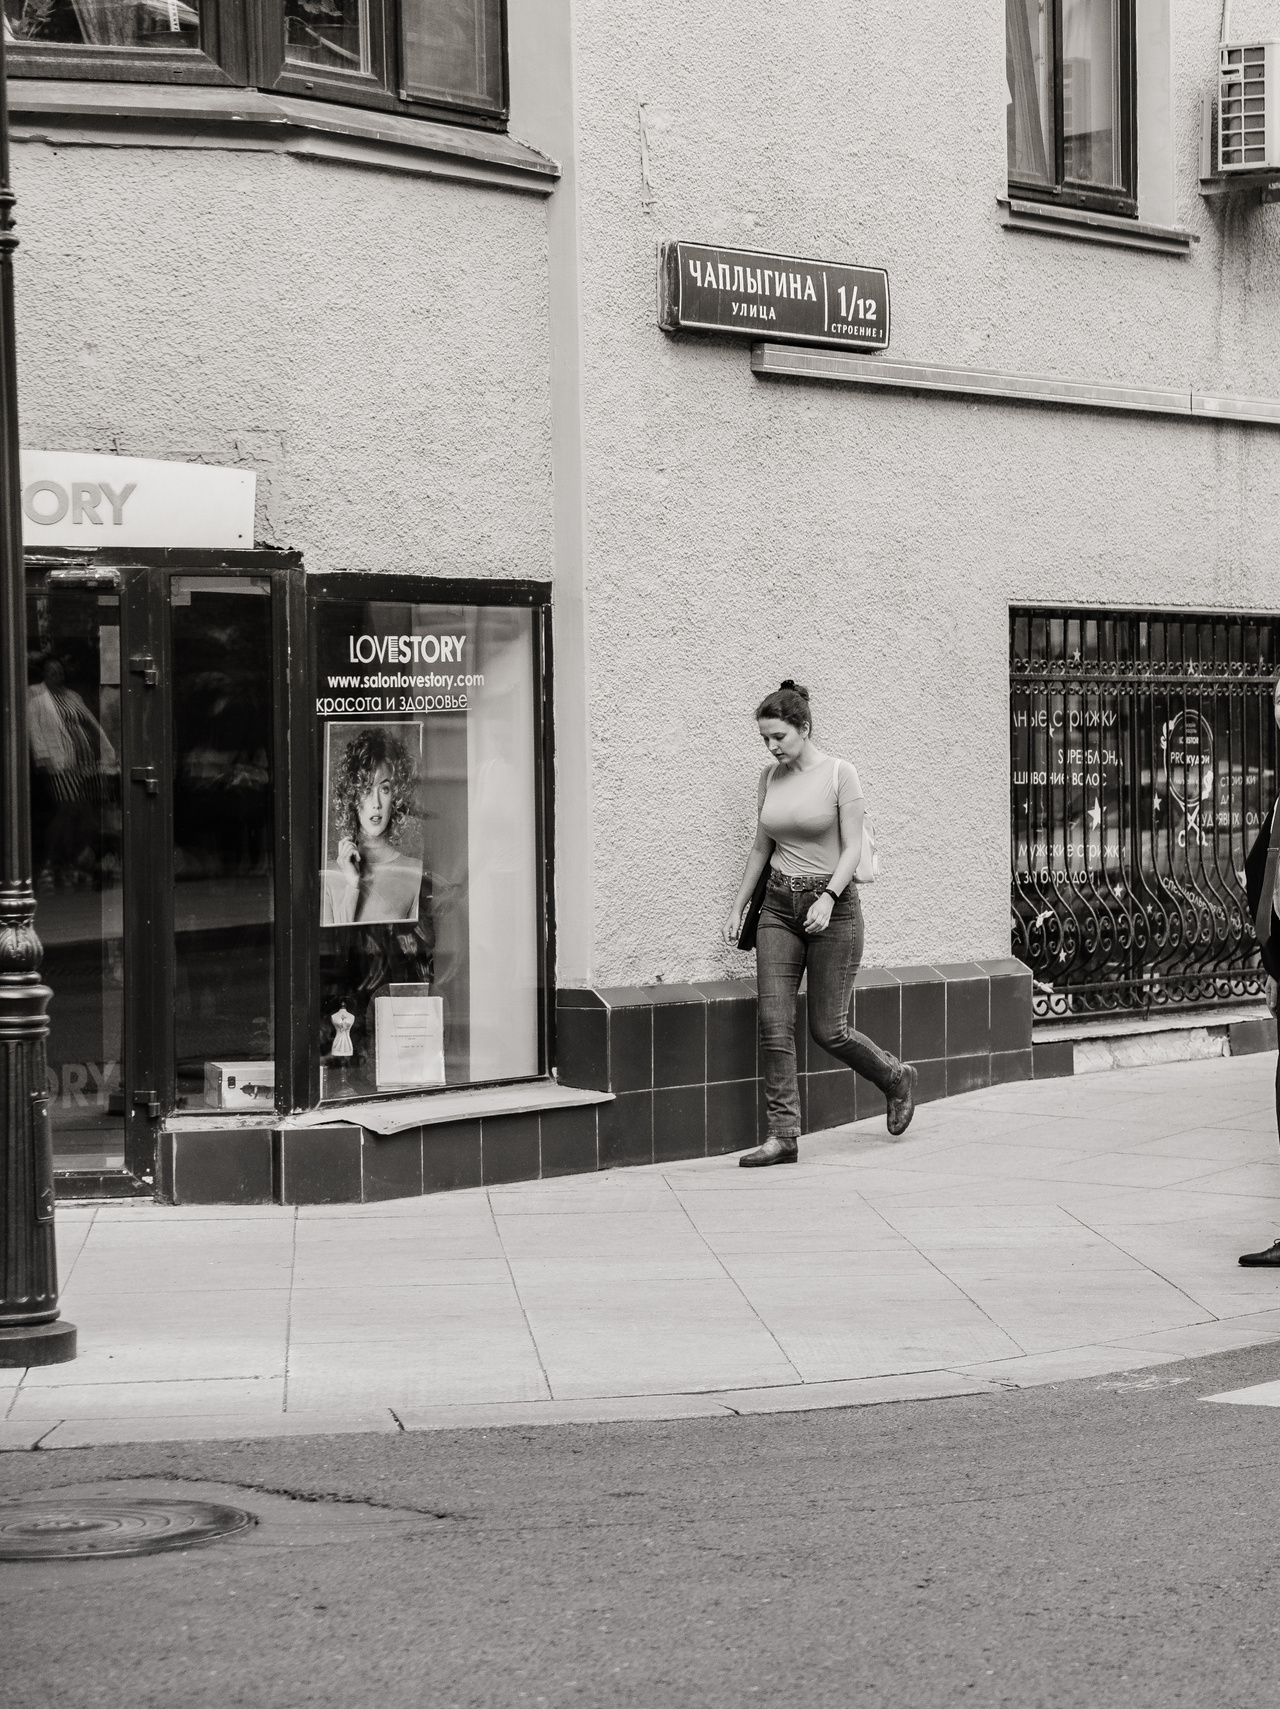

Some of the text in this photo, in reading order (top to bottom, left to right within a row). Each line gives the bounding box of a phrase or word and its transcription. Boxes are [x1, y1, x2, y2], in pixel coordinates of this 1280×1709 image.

[689, 259, 877, 322] ЧАПЛЫГИНА 1/12
[731, 302, 777, 321] УЛИЦА
[831, 323, 878, 338] СТРОЕНИЕ
[23, 480, 138, 526] ORY
[349, 634, 467, 664] LOVESTORY
[327, 672, 485, 691] www.salonlovestory.com
[316, 693, 468, 716] красота и здоровье
[1052, 709, 1117, 732] срижки
[1076, 844, 1126, 861] срижки
